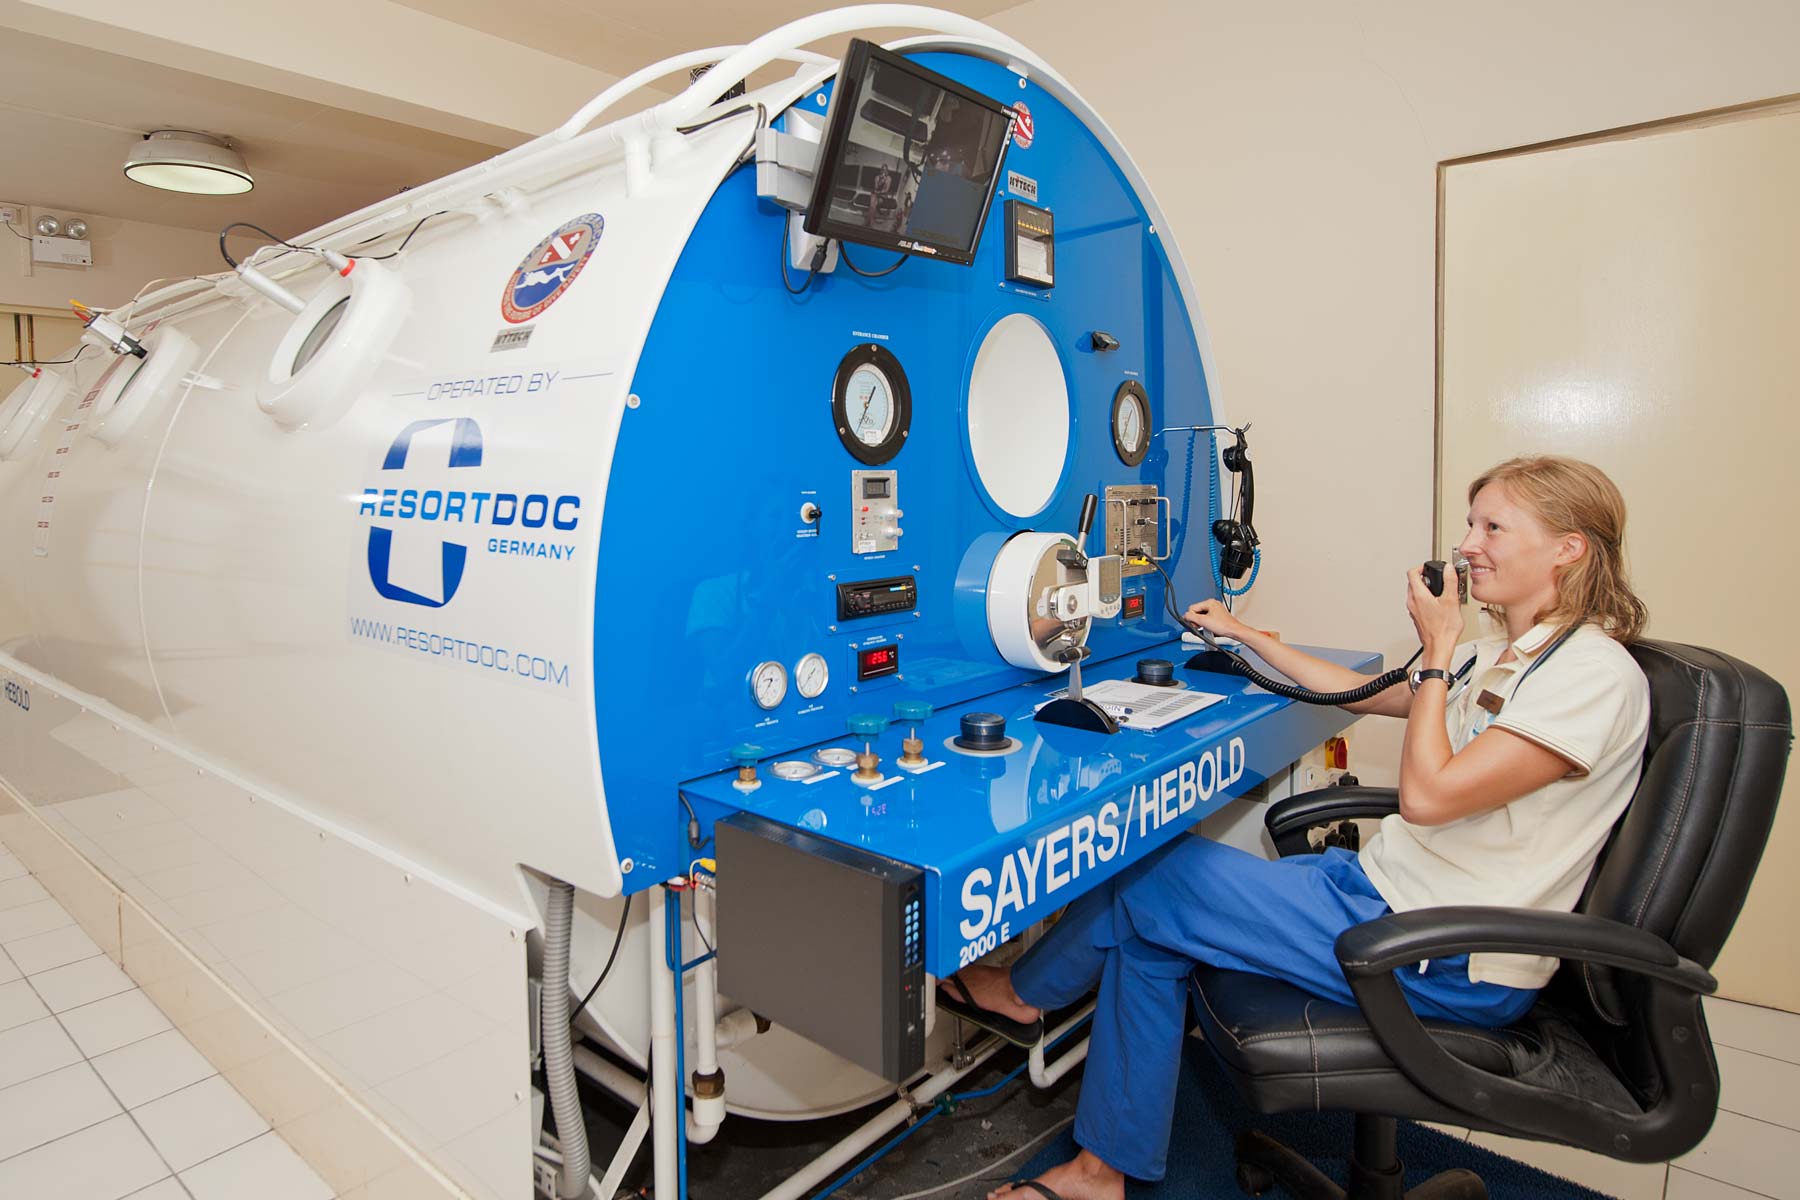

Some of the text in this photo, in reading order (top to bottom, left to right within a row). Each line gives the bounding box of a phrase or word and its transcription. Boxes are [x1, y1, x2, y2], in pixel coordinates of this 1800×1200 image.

[1009, 176, 1036, 195] HYTECH
[427, 371, 560, 400] OPERATED BY
[359, 488, 581, 531] RESORTDOC
[488, 538, 576, 561] GERMANY
[350, 616, 569, 687] WWW.RESORTDOC.COM
[959, 922, 1010, 968] 2000 E
